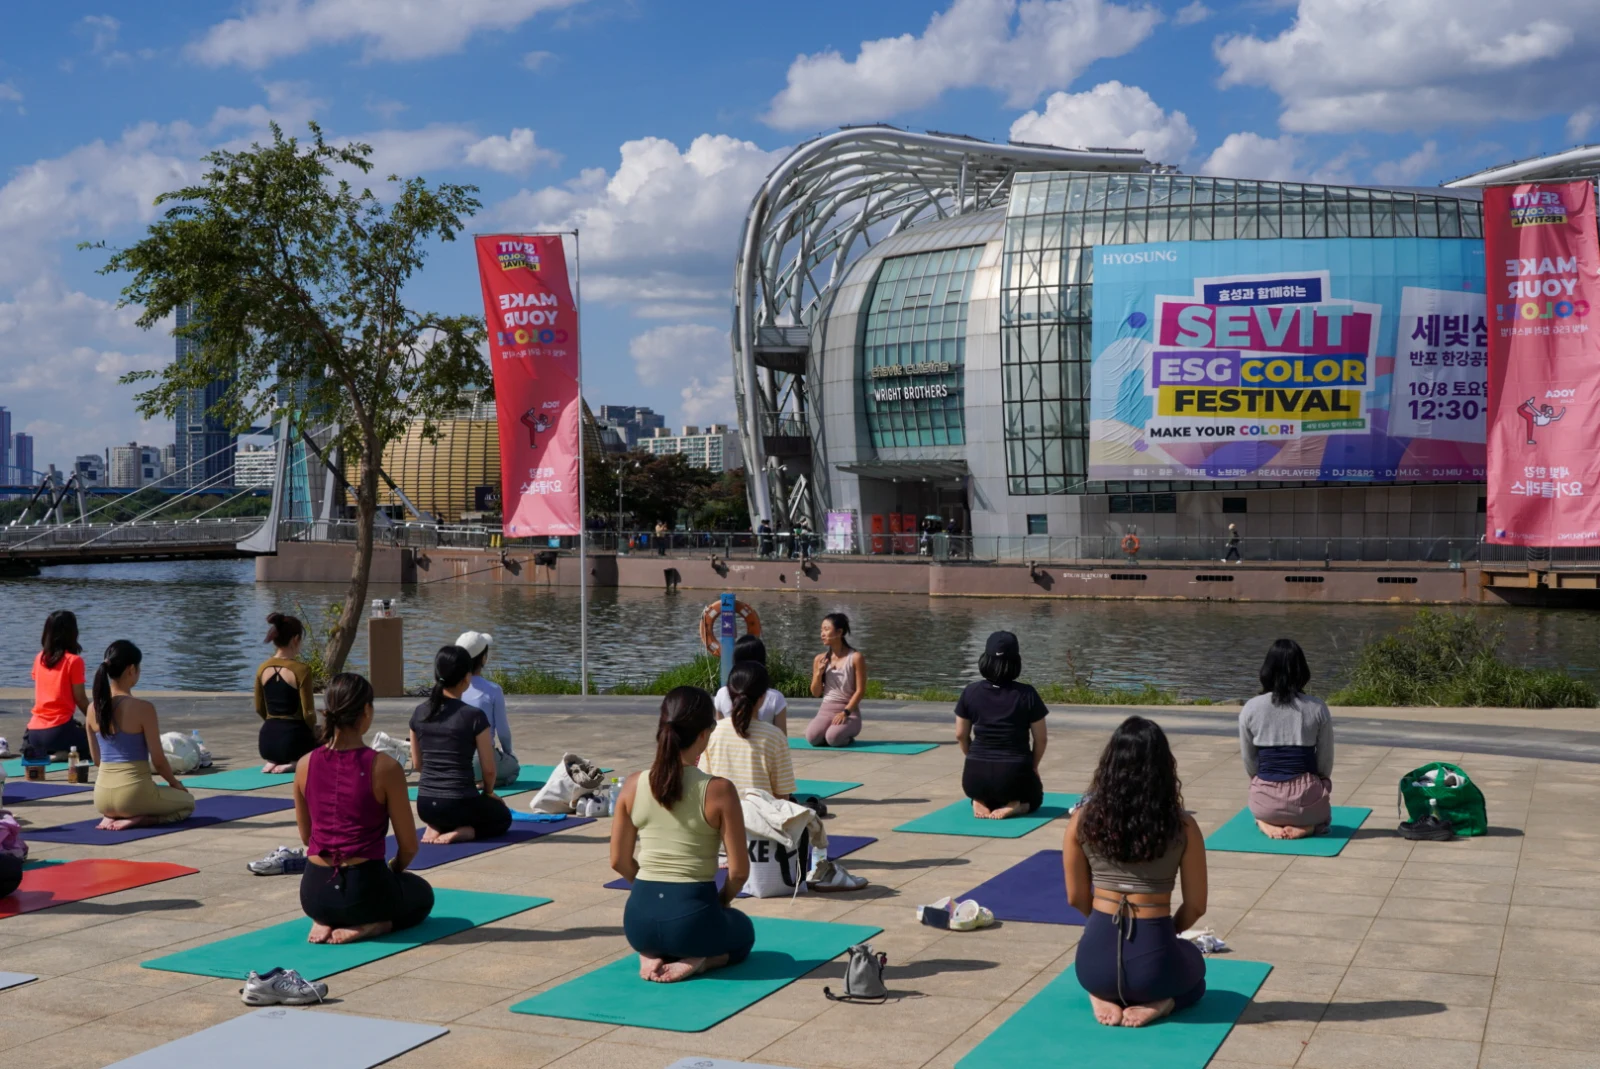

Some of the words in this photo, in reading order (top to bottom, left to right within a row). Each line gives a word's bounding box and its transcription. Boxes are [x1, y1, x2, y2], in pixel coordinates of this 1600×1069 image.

[1102, 250, 1177, 265] HYOSUNG
[1218, 288, 1254, 302] 효성과
[1257, 285, 1306, 300] 함께하는
[1175, 304, 1353, 348] SEVIT
[1409, 350, 1437, 367] 반포
[1159, 357, 1232, 383] ESG
[1240, 358, 1365, 383] COLOR
[874, 387, 902, 402] WRIGHT
[903, 383, 948, 400] BROTHERS
[1408, 381, 1448, 397] 10/8
[1174, 388, 1352, 413] FESTIVAL
[1150, 427, 1191, 437] MAKE
[1196, 425, 1235, 436] YOUR
[1239, 424, 1294, 436] COLOR!
[1258, 469, 1321, 477] REALPLAYERS
[1332, 469, 1345, 477] DJ
[1385, 469, 1398, 477] DJ
[1432, 468, 1446, 476] DJ
[1472, 468, 1485, 476] DJ
[747, 840, 770, 863] KE
